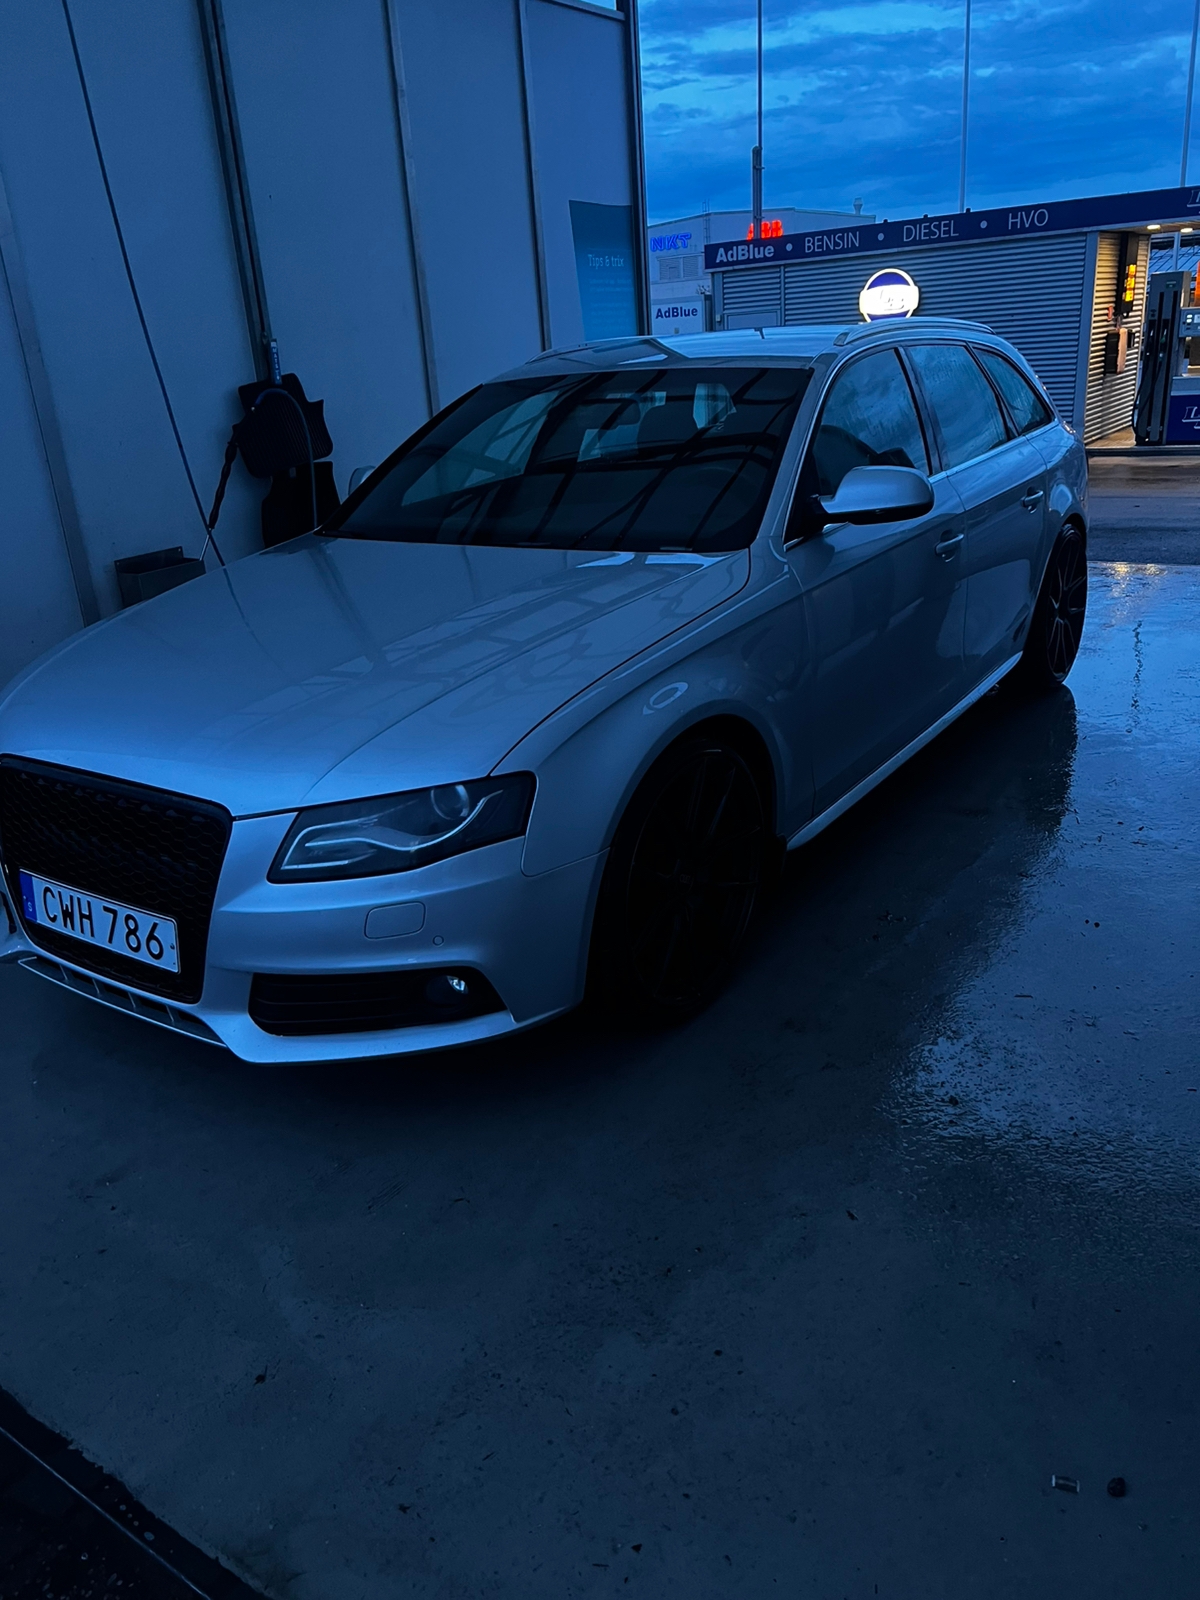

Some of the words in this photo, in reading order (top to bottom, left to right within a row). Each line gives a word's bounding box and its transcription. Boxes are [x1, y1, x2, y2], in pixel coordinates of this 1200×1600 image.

[650, 232, 692, 252] NKT
[715, 244, 775, 264] AdBlue
[804, 231, 860, 254] BENSIN
[903, 219, 959, 242] DIESEL
[1007, 208, 1049, 230] HVO
[587, 253, 603, 270] Tips
[604, 255, 610, 267] &
[611, 254, 625, 267] trix
[655, 306, 698, 320] AdBlue
[27, 901, 33, 912] S
[43, 886, 95, 938] CWH
[102, 905, 164, 960] 786
